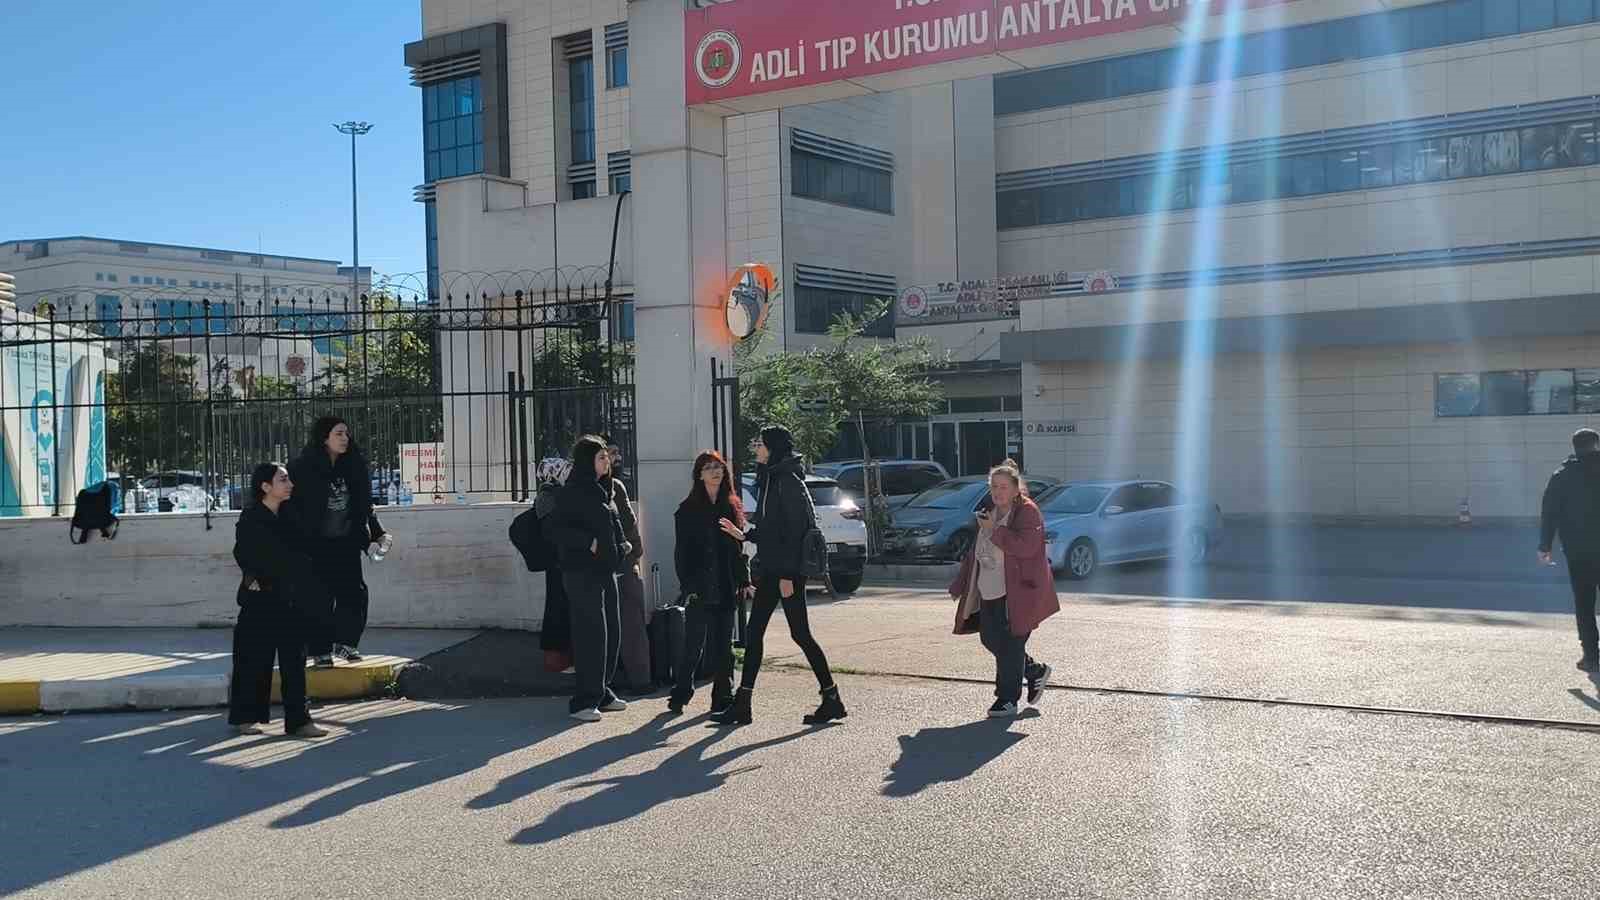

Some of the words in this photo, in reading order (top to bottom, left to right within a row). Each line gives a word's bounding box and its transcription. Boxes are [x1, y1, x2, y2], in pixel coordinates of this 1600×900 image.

[750, 39, 805, 83] ADLİ
[815, 36, 857, 71] TIP
[864, 9, 988, 64] KURUMU
[999, 0, 1137, 39] ANTALYA
